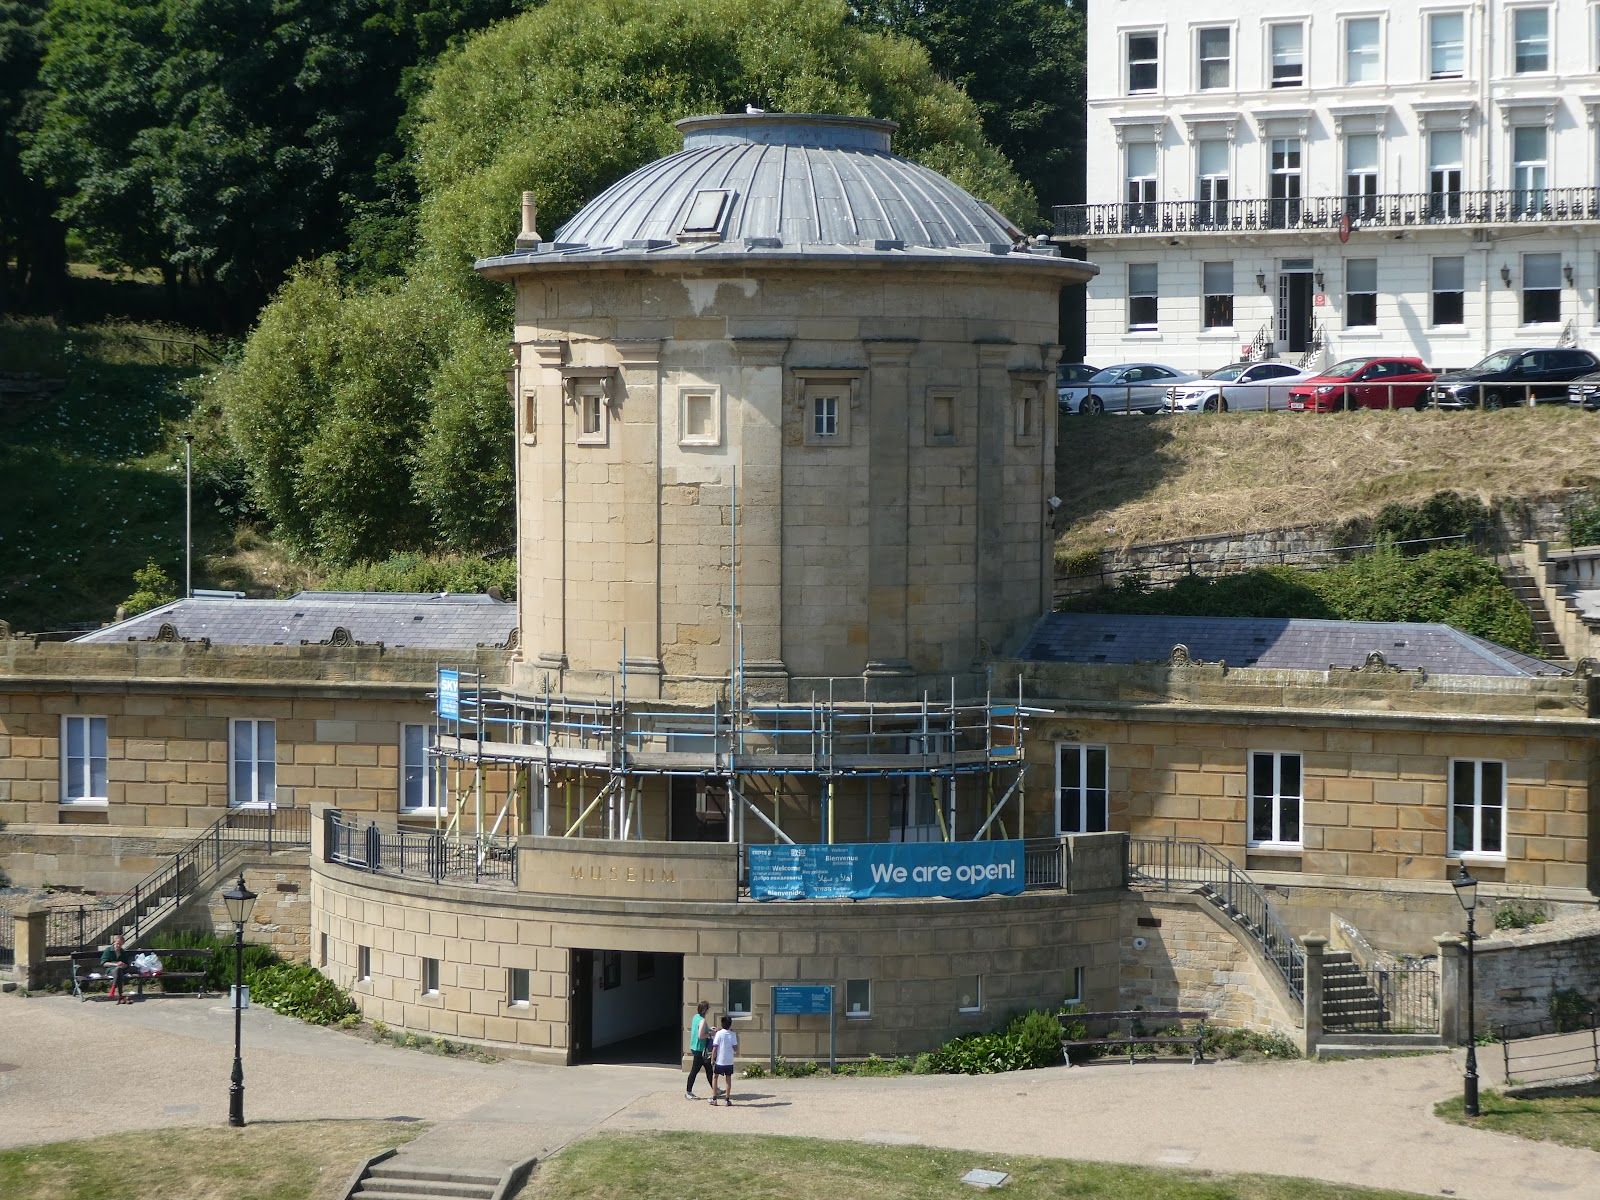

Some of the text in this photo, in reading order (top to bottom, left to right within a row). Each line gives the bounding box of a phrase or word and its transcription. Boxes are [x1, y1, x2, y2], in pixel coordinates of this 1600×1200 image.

[441, 679, 458, 692] SKY
[570, 865, 676, 883] MUSEUM
[871, 860, 1015, 884] We are open!
